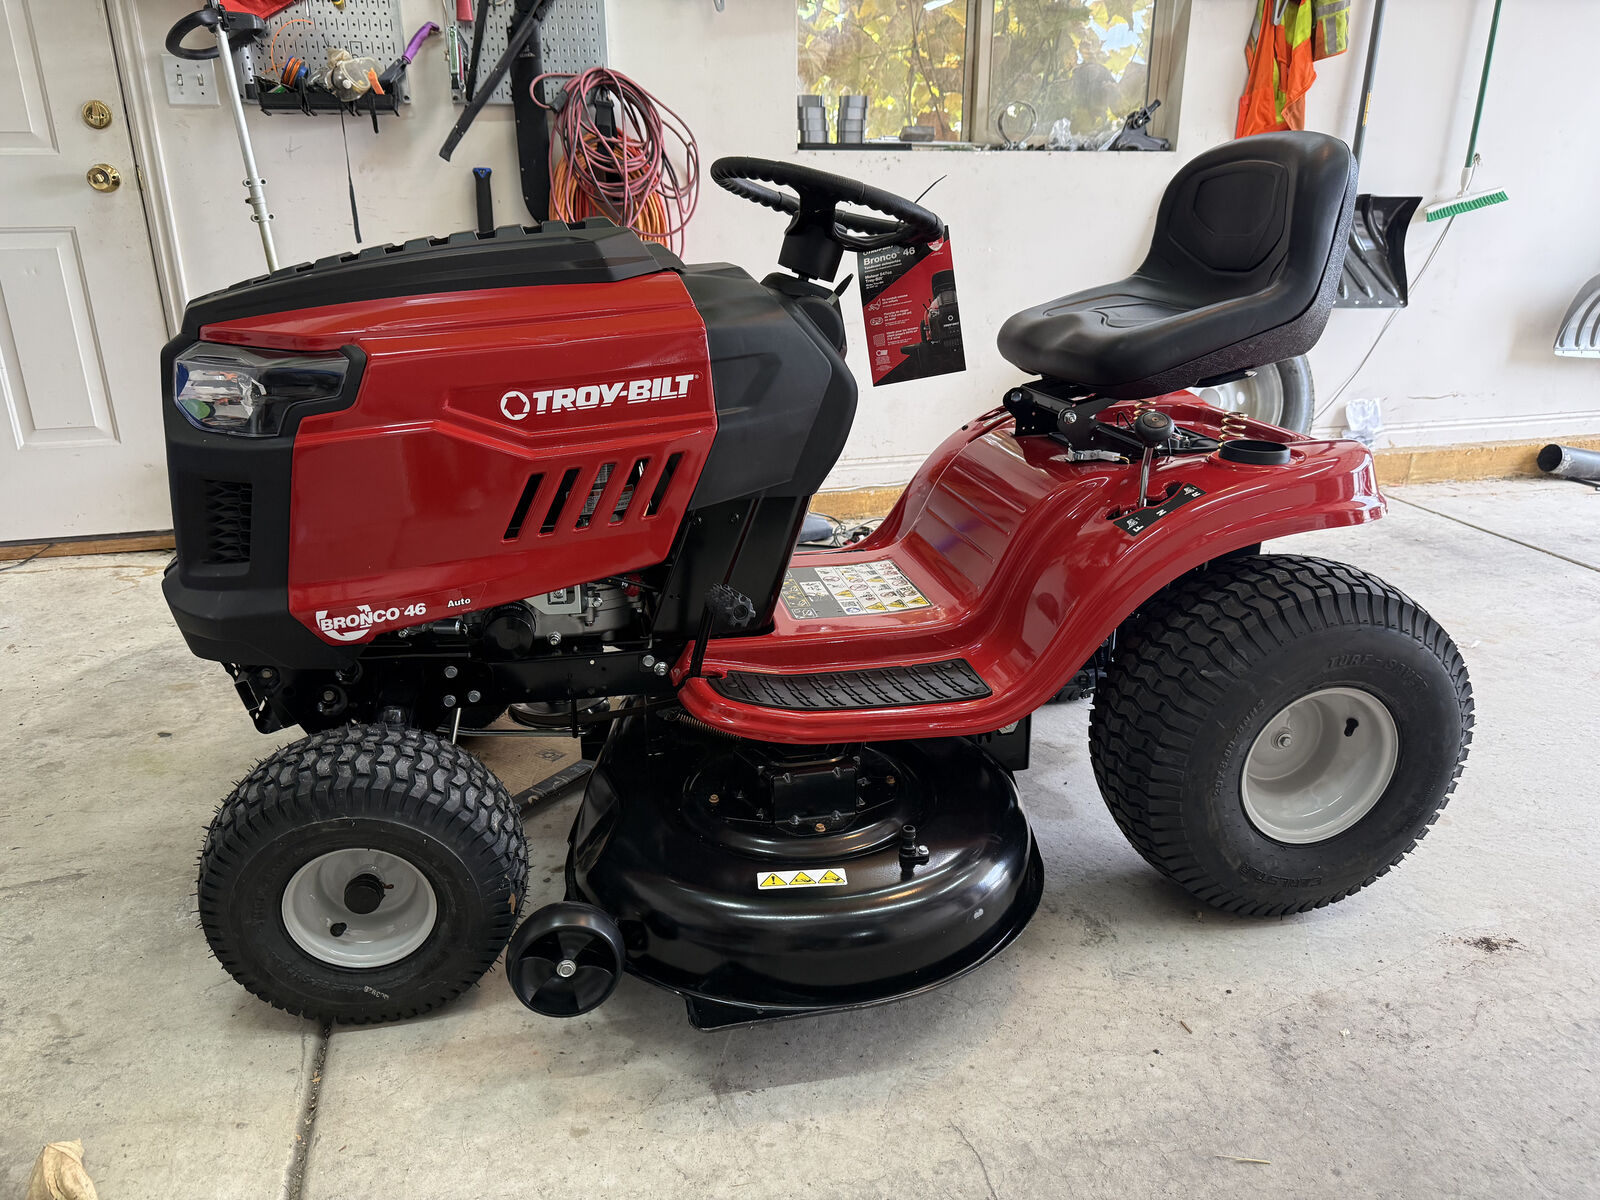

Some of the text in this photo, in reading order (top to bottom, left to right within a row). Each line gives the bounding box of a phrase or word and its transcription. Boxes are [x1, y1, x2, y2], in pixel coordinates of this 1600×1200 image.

[863, 246, 915, 265] Bronco 46
[447, 597, 471, 608] Auto
[319, 603, 427, 632] BRONCO 46
